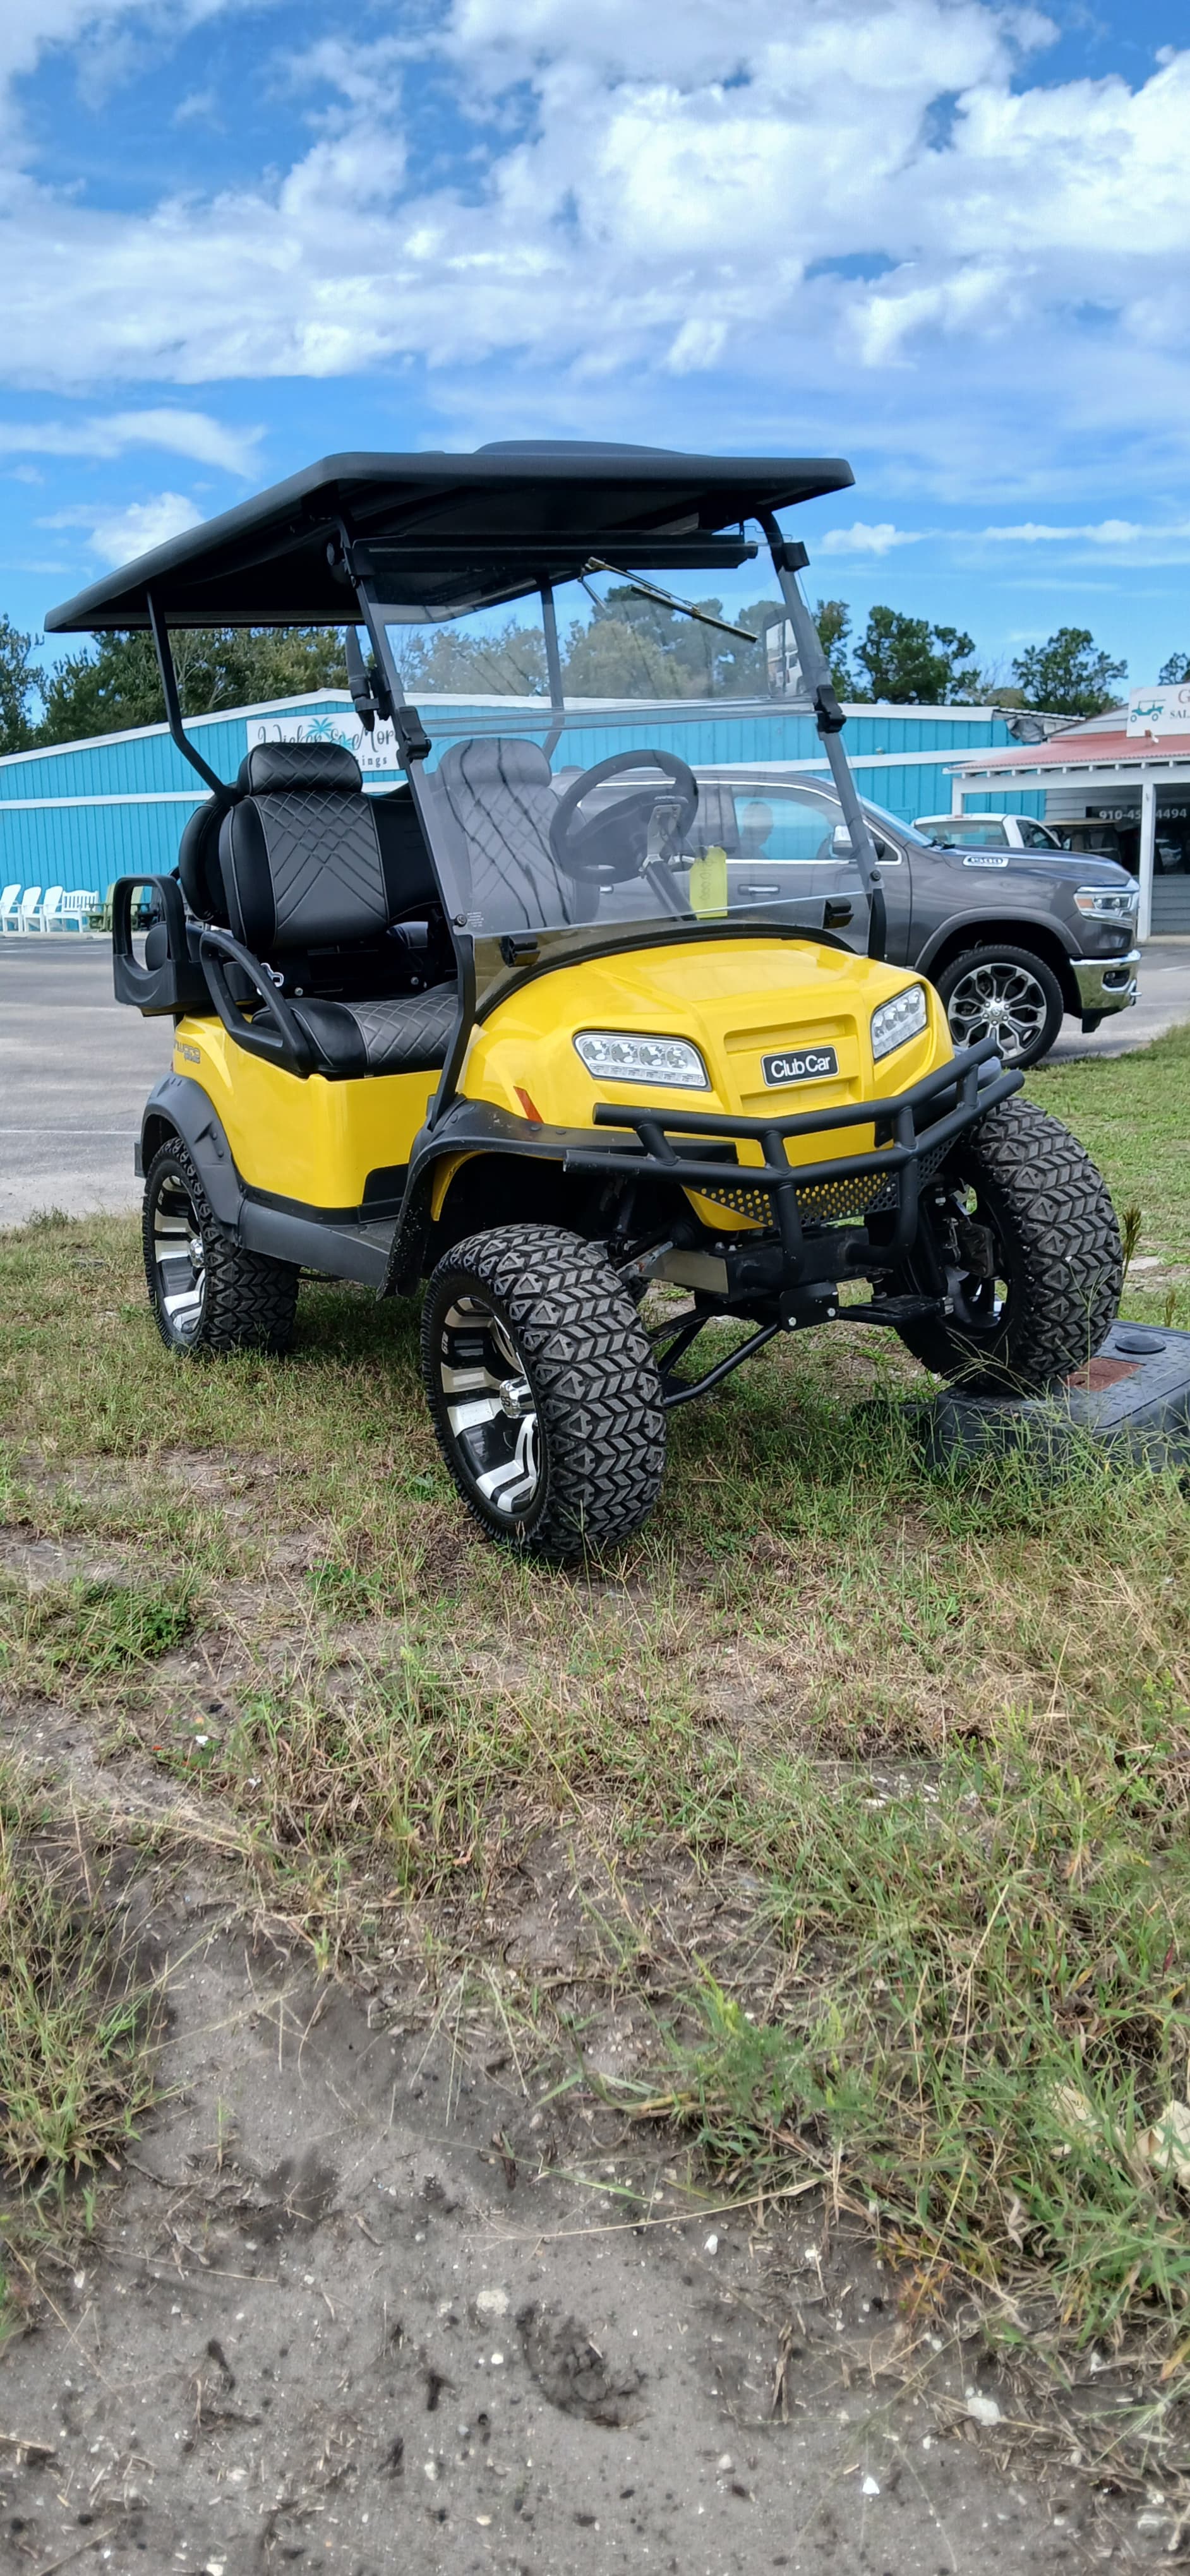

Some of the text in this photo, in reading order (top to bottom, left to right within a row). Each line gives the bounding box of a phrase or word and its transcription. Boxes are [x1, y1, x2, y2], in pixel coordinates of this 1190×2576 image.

[352, 727, 394, 753] Mor
[771, 1055, 831, 1078] Club Car
